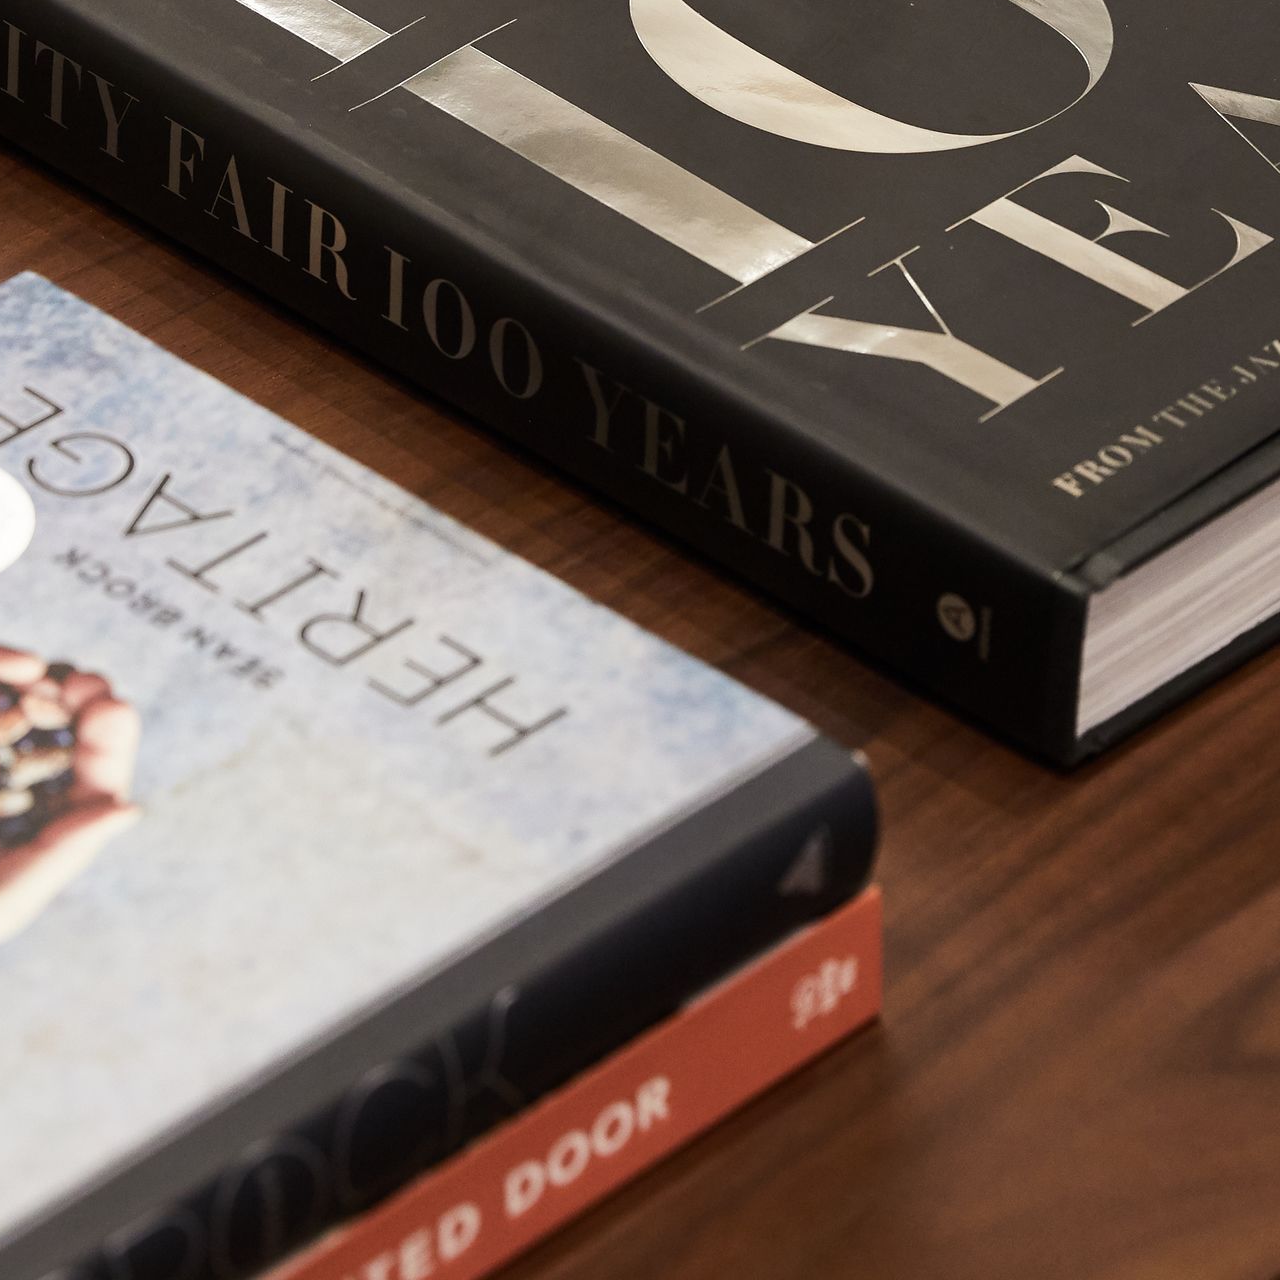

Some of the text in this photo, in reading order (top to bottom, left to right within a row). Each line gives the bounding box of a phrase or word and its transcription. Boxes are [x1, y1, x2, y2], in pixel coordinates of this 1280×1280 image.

[161, 116, 357, 300] FAIR
[381, 246, 544, 400] 100
[571, 356, 875, 599] YEARS
[1051, 424, 1166, 498] FROM
[1152, 379, 1236, 429] THE
[53, 547, 286, 690] SEAN BROCK
[340, 1075, 671, 1280] TED DOOR
